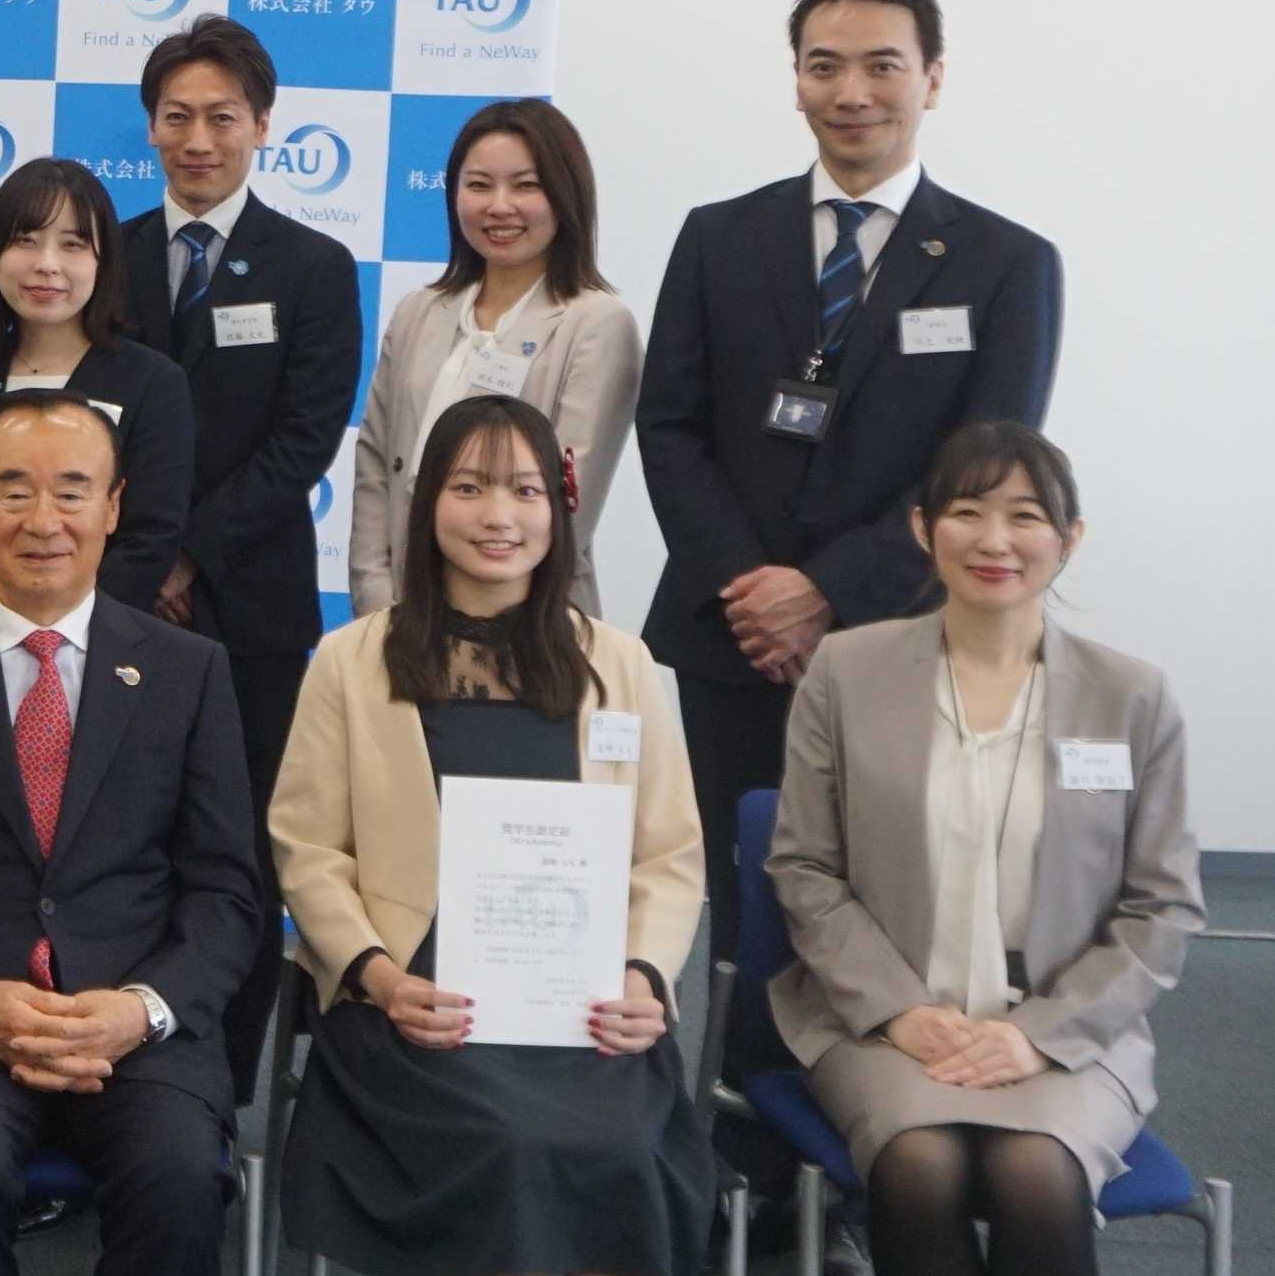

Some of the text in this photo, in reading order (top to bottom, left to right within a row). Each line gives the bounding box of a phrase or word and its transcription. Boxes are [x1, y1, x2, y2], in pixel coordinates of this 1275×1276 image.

[83, 31, 120, 46] Find
[125, 36, 135, 47] a
[419, 42, 541, 63] Find a NeWay
[254, 146, 322, 175] TAU
[407, 169, 448, 190] 株式
